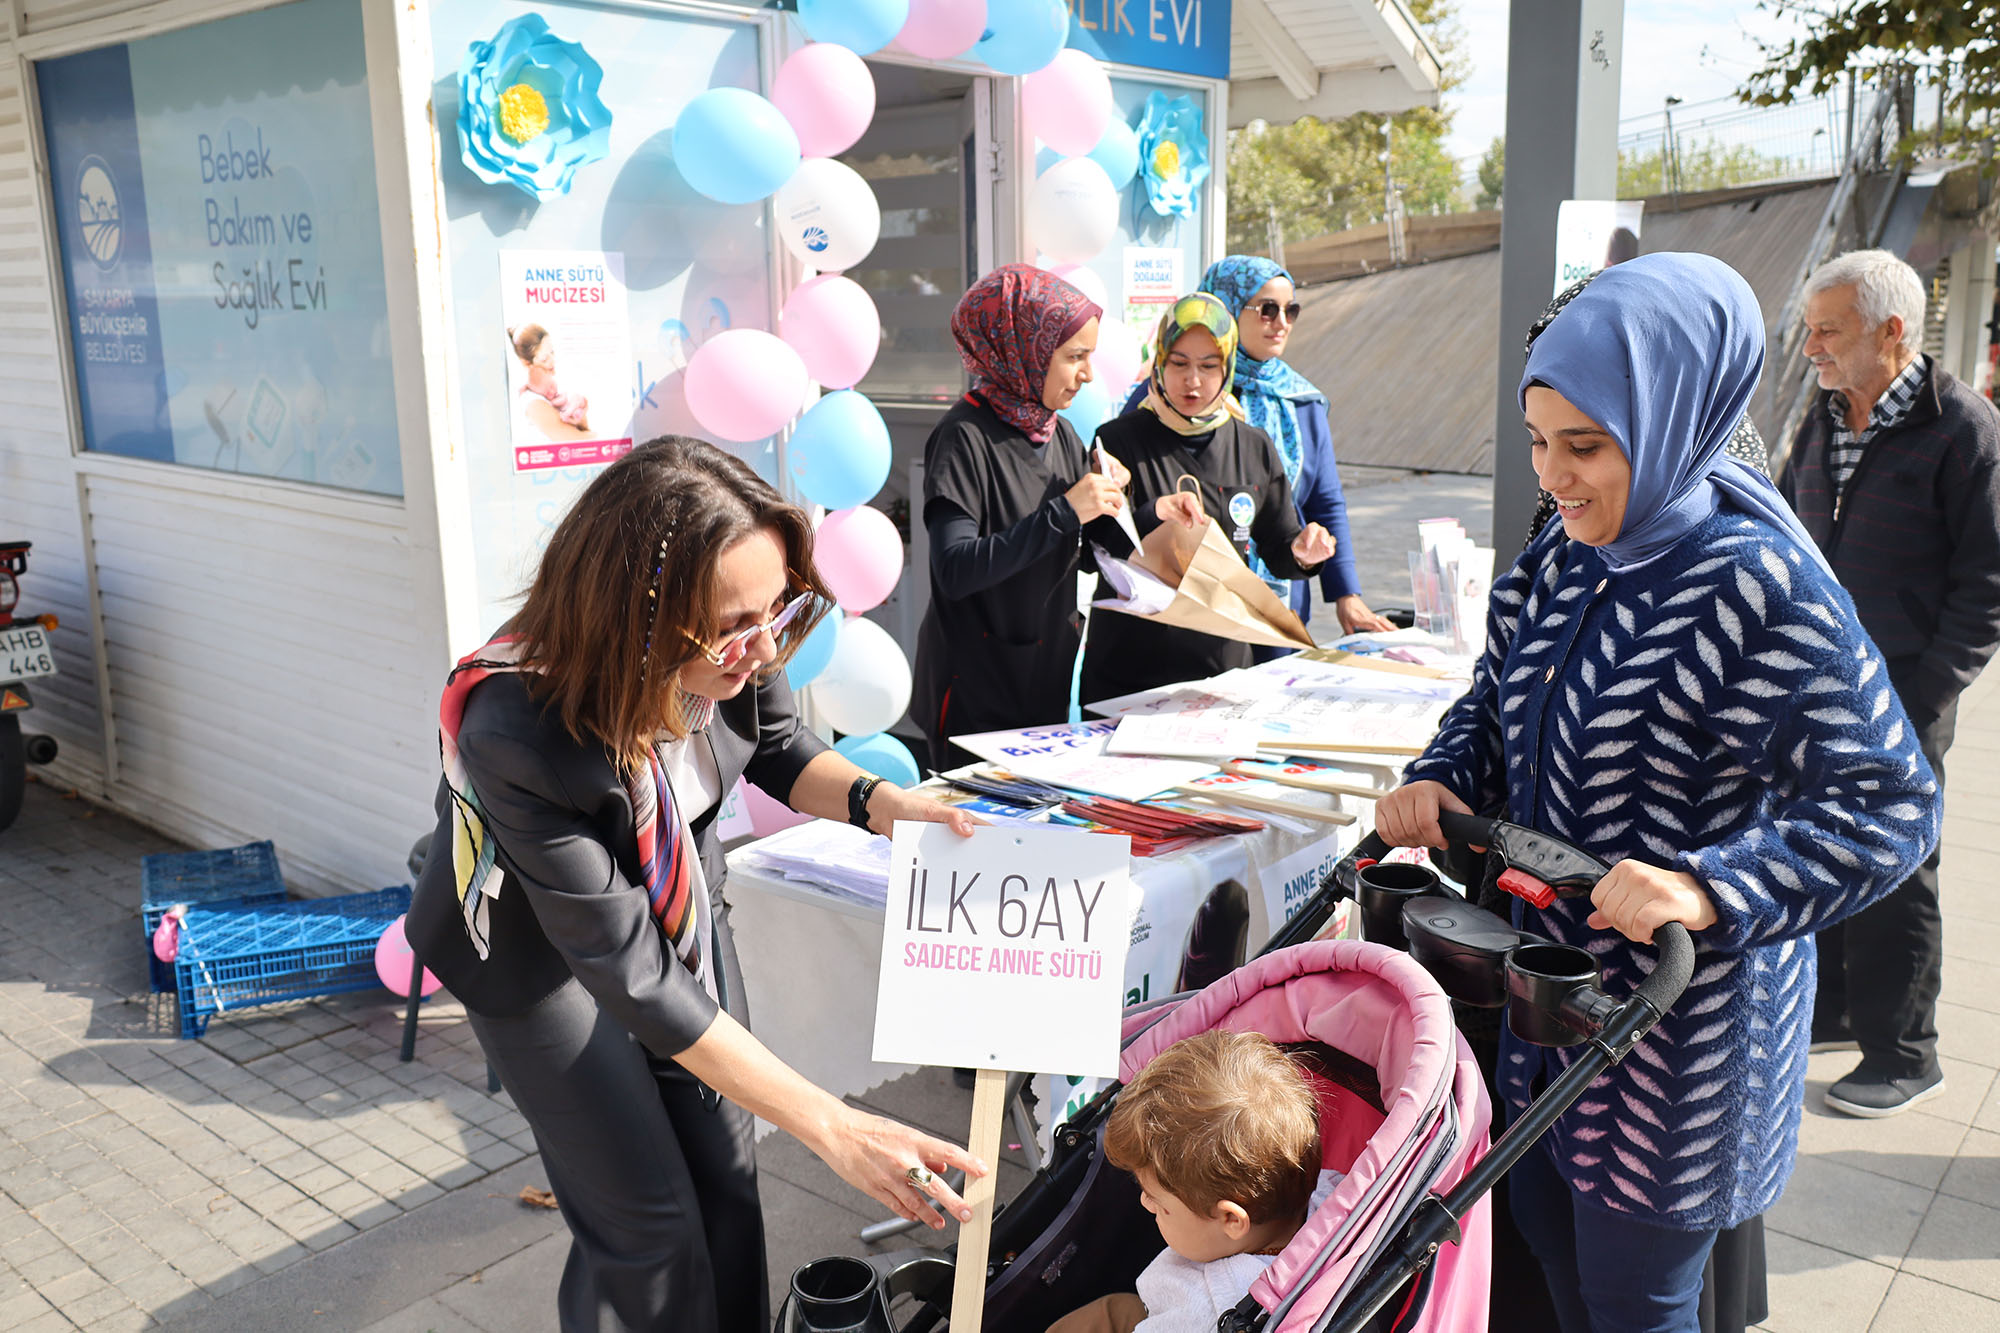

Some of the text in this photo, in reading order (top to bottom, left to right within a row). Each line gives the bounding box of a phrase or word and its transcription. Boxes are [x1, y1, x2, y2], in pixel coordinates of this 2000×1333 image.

[199, 127, 273, 183] Bebek
[205, 197, 312, 246] Bakım ve
[525, 265, 604, 282] ANNE SÜTÜ
[84, 288, 136, 308] SAKARYA
[213, 259, 327, 330] Sağlık Evi
[526, 282, 605, 303] MUCİZESİ
[80, 312, 147, 336] BÜYÜKŞEHİR
[86, 341, 147, 363] BELEDİYESİ
[10, 653, 51, 676] 446
[906, 857, 981, 935] İLK
[1284, 868, 1316, 903] ANNE
[904, 942, 1102, 980] SADECE ANNE SÜTÜ
